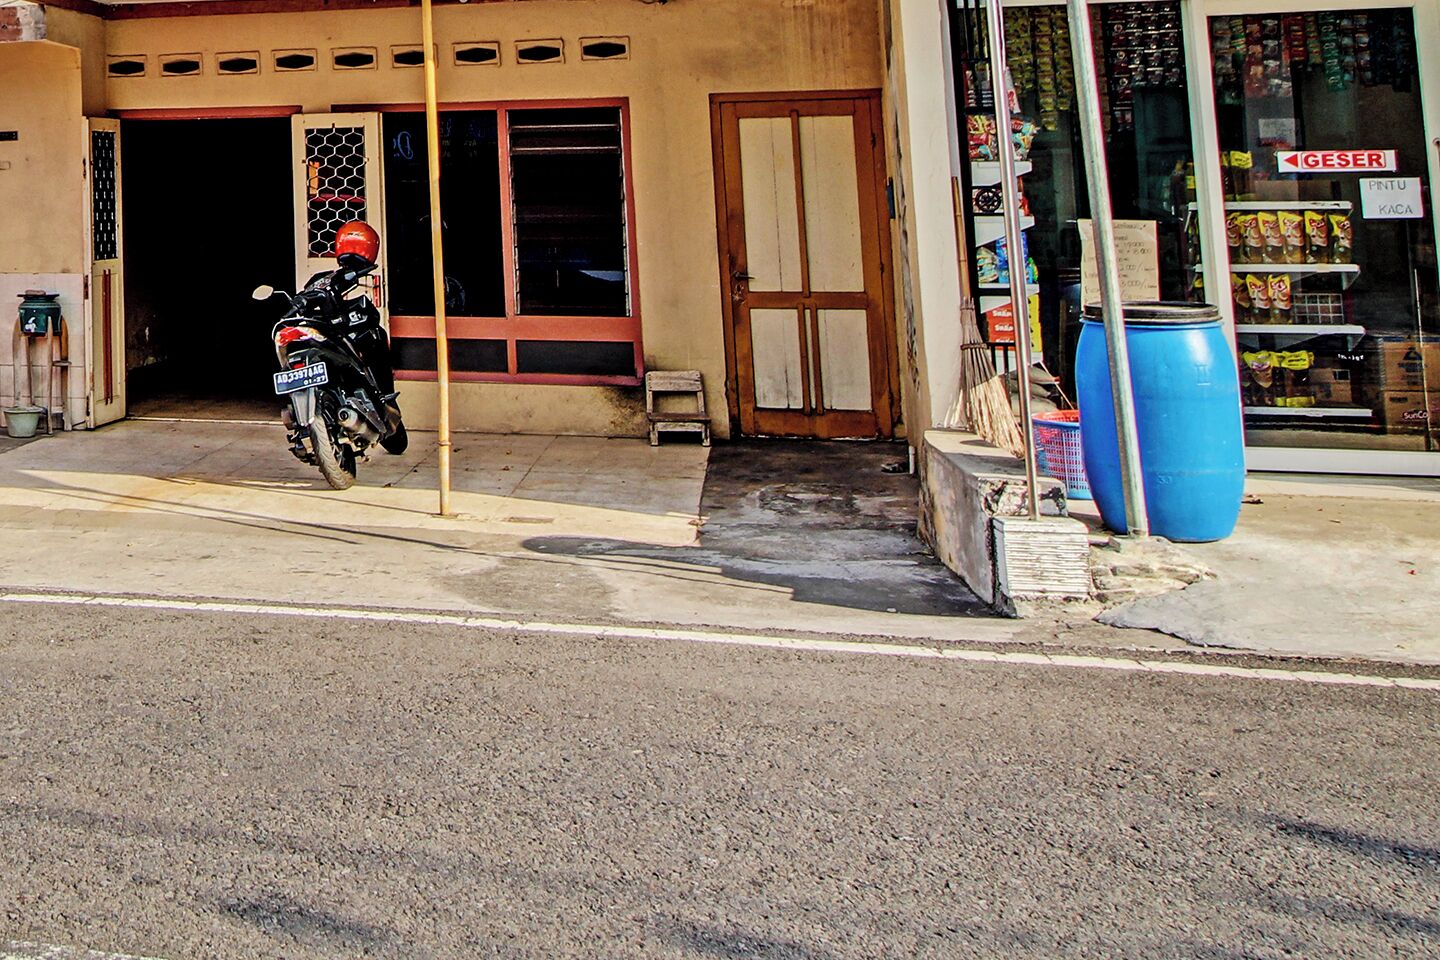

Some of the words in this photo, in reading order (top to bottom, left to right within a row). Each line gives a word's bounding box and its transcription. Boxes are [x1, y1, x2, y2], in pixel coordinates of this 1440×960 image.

[1303, 153, 1385, 169] GESER
[1368, 179, 1407, 191] PINTU
[1378, 203, 1414, 215] KACA
